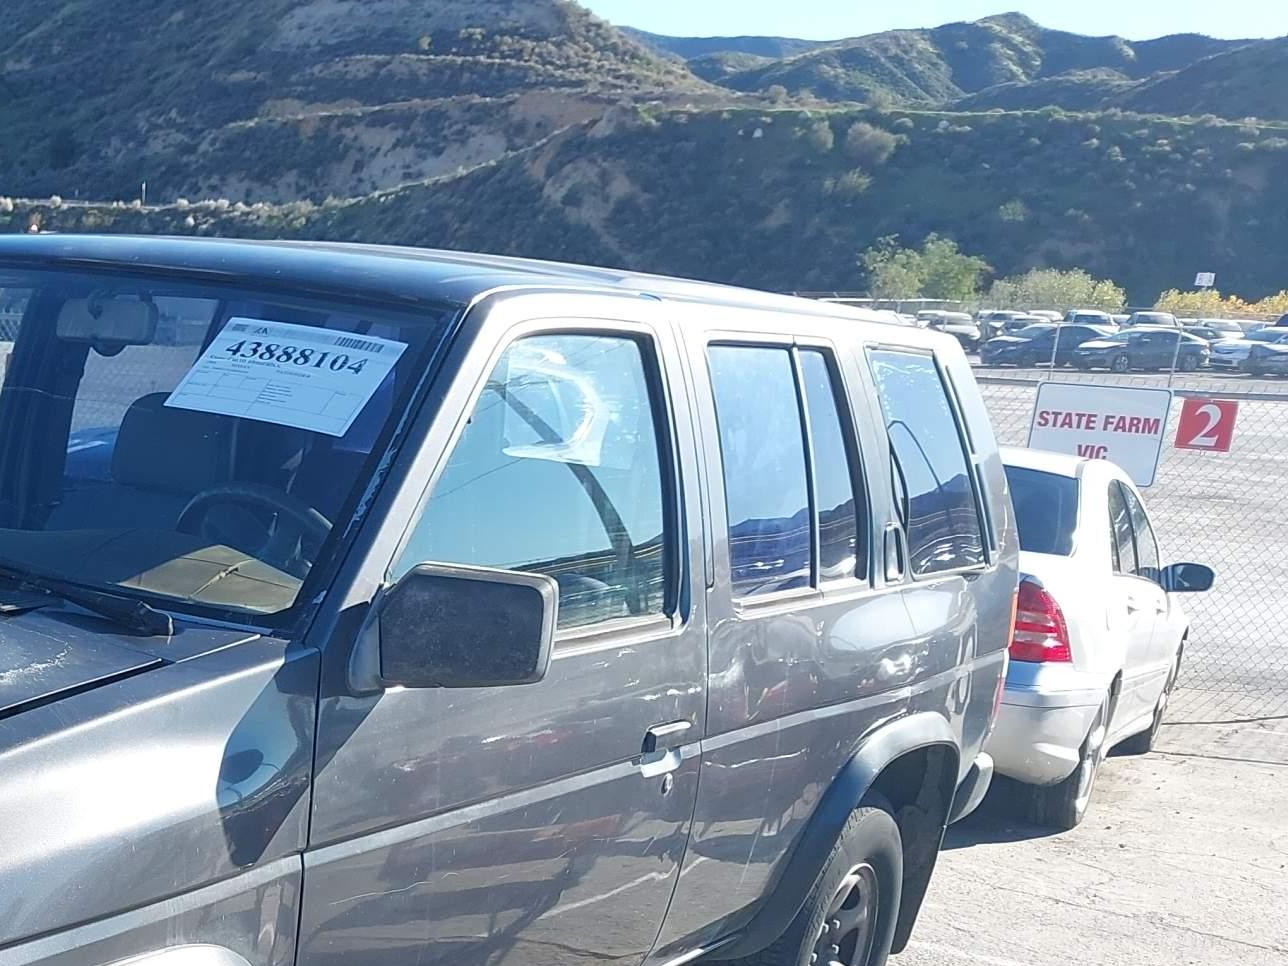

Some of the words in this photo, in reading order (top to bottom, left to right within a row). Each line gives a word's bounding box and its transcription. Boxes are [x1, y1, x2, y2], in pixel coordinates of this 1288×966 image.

[225, 339, 368, 375] 43888104
[1037, 410, 1097, 430] STATE
[1103, 415, 1160, 434] FARM
[1188, 404, 1222, 446] 2
[1077, 444, 1108, 459] VIC
